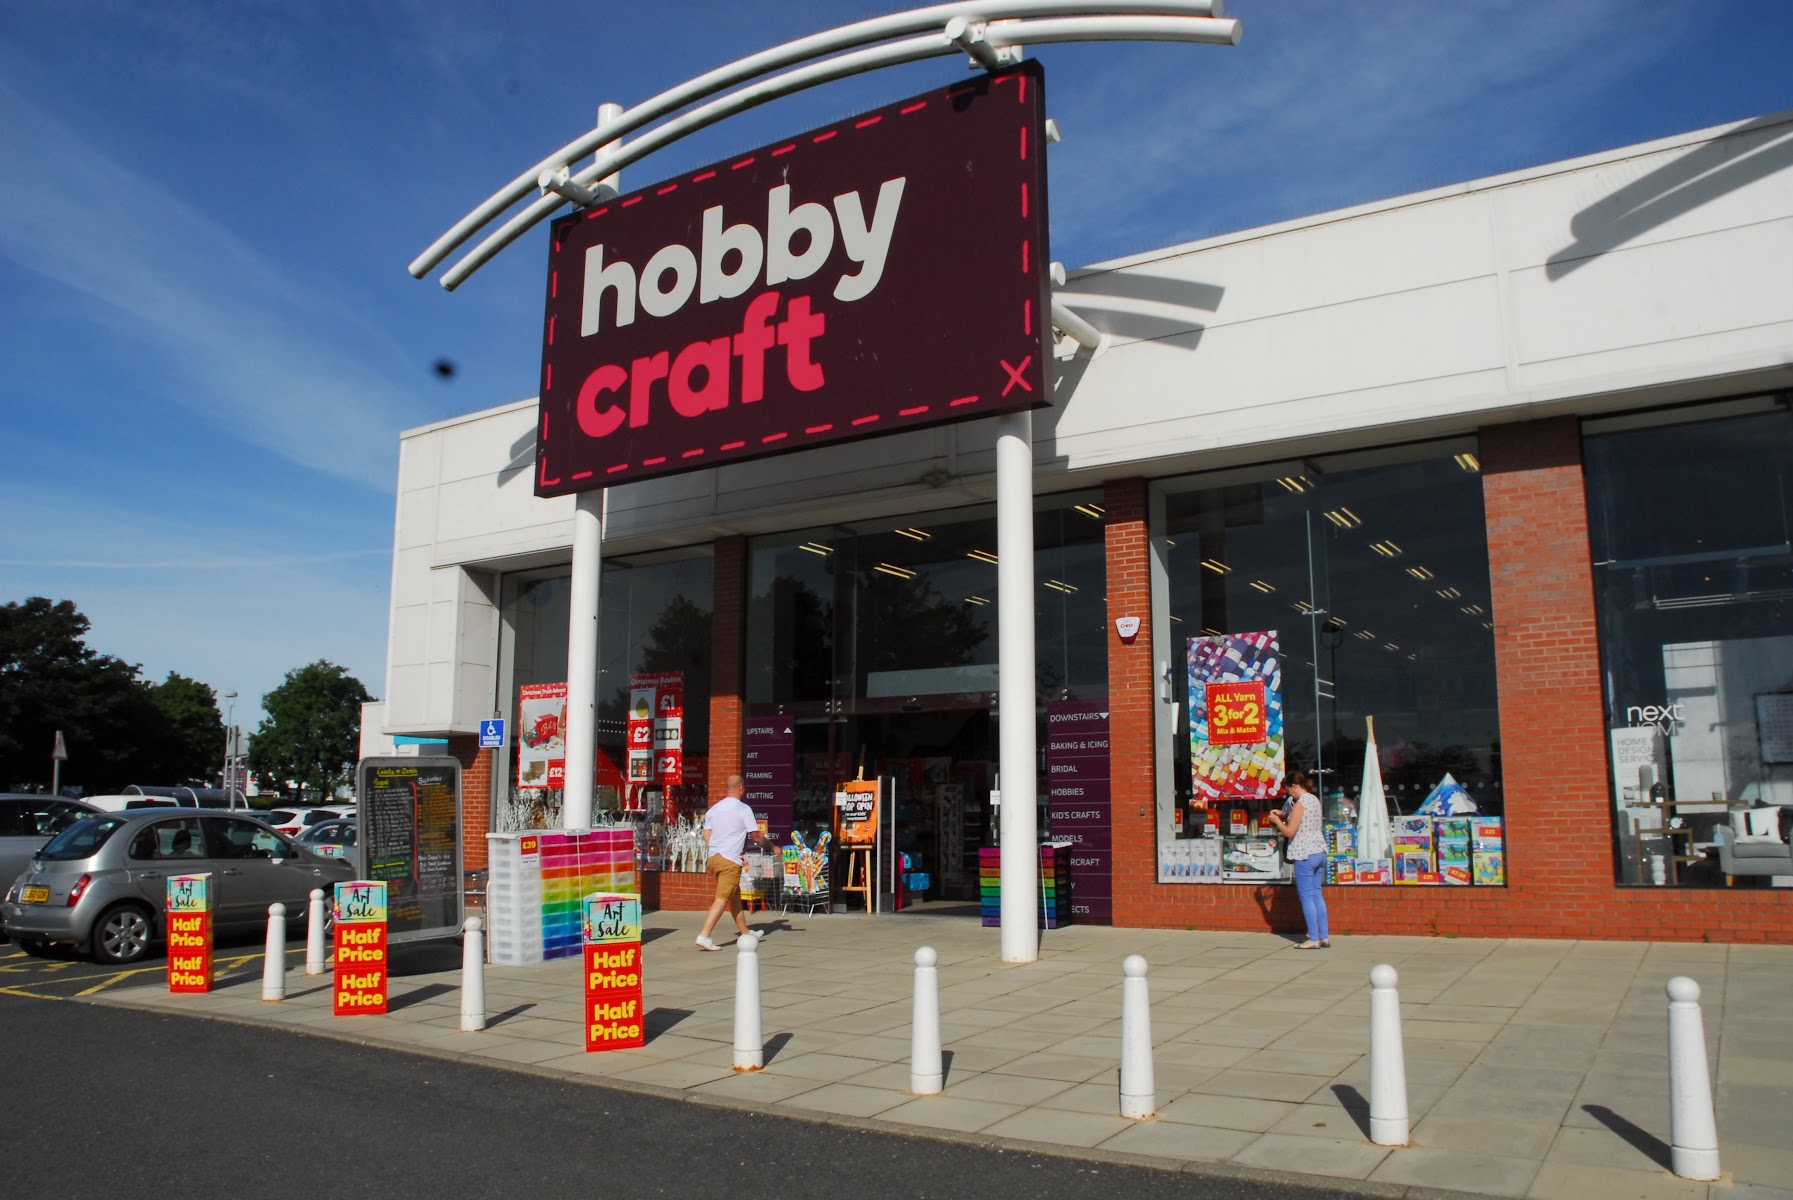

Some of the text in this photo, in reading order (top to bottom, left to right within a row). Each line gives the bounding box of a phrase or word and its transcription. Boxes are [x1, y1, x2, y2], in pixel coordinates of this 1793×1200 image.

[581, 177, 906, 337] hobby
[577, 292, 825, 438] craft
[630, 678, 659, 686] Christmas
[660, 694, 675, 710] £1
[1214, 692, 1256, 703] ALL Yarn
[1050, 712, 1099, 722] DOWNSTAIRS
[1626, 703, 1686, 722] next
[633, 726, 650, 743] £2
[746, 727, 774, 735] UPSTAIRS
[1050, 740, 1108, 750] BAKING & ICING
[1616, 737, 1647, 746] HOME
[1617, 746, 1655, 755] DESIGN
[657, 756, 676, 773] £2
[1050, 765, 1078, 773] BRIDAL
[549, 767, 563, 778] £12
[1051, 788, 1084, 796] HOBBIES
[856, 801, 873, 810] OPEN
[1051, 811, 1100, 819] KID'S CRAFTS
[323, 849, 334, 857] Art
[522, 841, 536, 850] £39
[1070, 858, 1100, 866] RCRAFT
[180, 881, 194, 896] Art
[352, 887, 372, 904] Art
[175, 895, 198, 908] Sale
[346, 903, 376, 918] Sale
[603, 901, 626, 921] Art
[172, 917, 202, 931] Half
[597, 919, 630, 938] Sale
[170, 932, 204, 947] Price
[341, 928, 382, 945] Half
[338, 946, 383, 963] Price
[593, 949, 636, 970] Half
[173, 956, 203, 970] Half
[171, 971, 205, 986] Price
[341, 972, 382, 989] Half
[589, 970, 638, 990] Price
[338, 990, 383, 1007] Price
[594, 1000, 637, 1021] Half
[590, 1022, 640, 1042] Price
